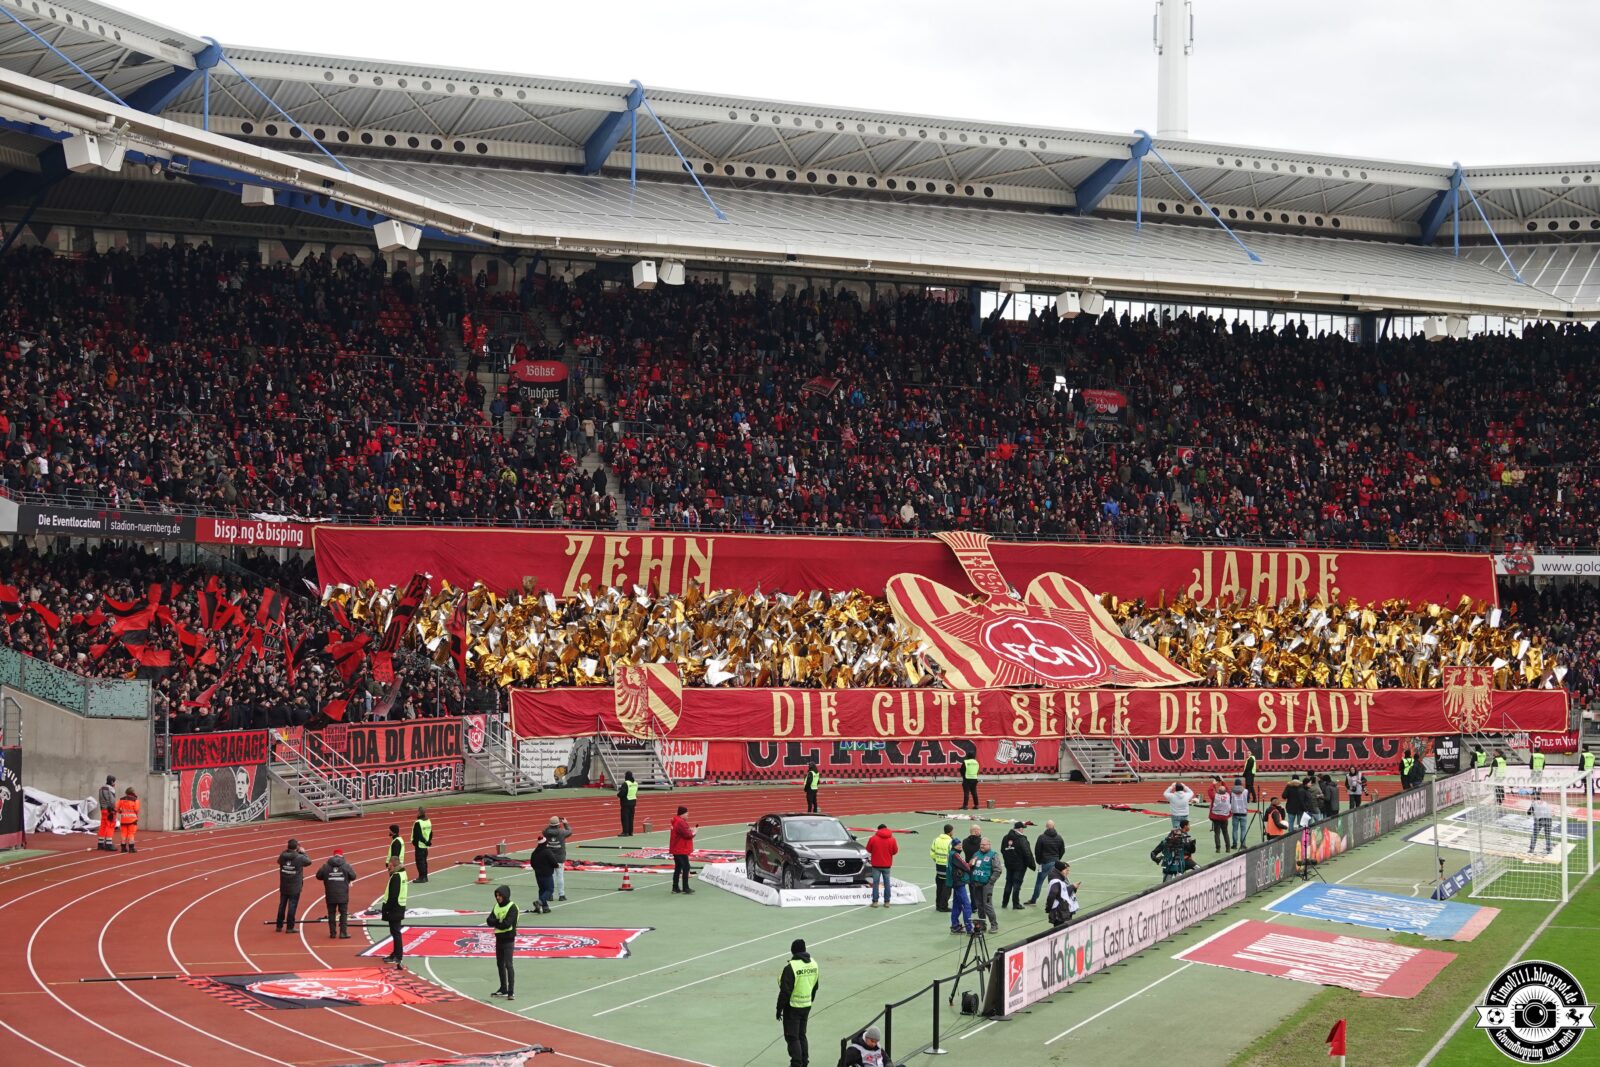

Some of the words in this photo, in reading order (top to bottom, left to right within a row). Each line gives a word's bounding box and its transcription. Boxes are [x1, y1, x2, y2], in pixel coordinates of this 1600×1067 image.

[38, 513, 51, 527] Die
[52, 514, 101, 529] Eventlocation
[110, 520, 181, 535] stadion-nuernberg.de
[214, 520, 254, 545] bispng
[255, 522, 265, 540] &
[266, 523, 304, 547] bisping
[562, 535, 715, 598] ZEHN
[1187, 551, 1341, 607] JAHRE
[1001, 641, 1095, 669] FCN
[771, 691, 841, 737] DIE
[871, 691, 983, 736] GUTE
[1010, 691, 1131, 735] SEELE
[1159, 692, 1229, 735] DER
[1257, 692, 1375, 734] STADT
[385, 728, 406, 763] DI
[411, 723, 461, 760] AMICI
[1103, 919, 1125, 959] Cash
[1127, 915, 1135, 948] &
[1137, 911, 1158, 944] Carry
[1161, 900, 1174, 928] für
[1174, 865, 1243, 925] Gastronomiebedarf
